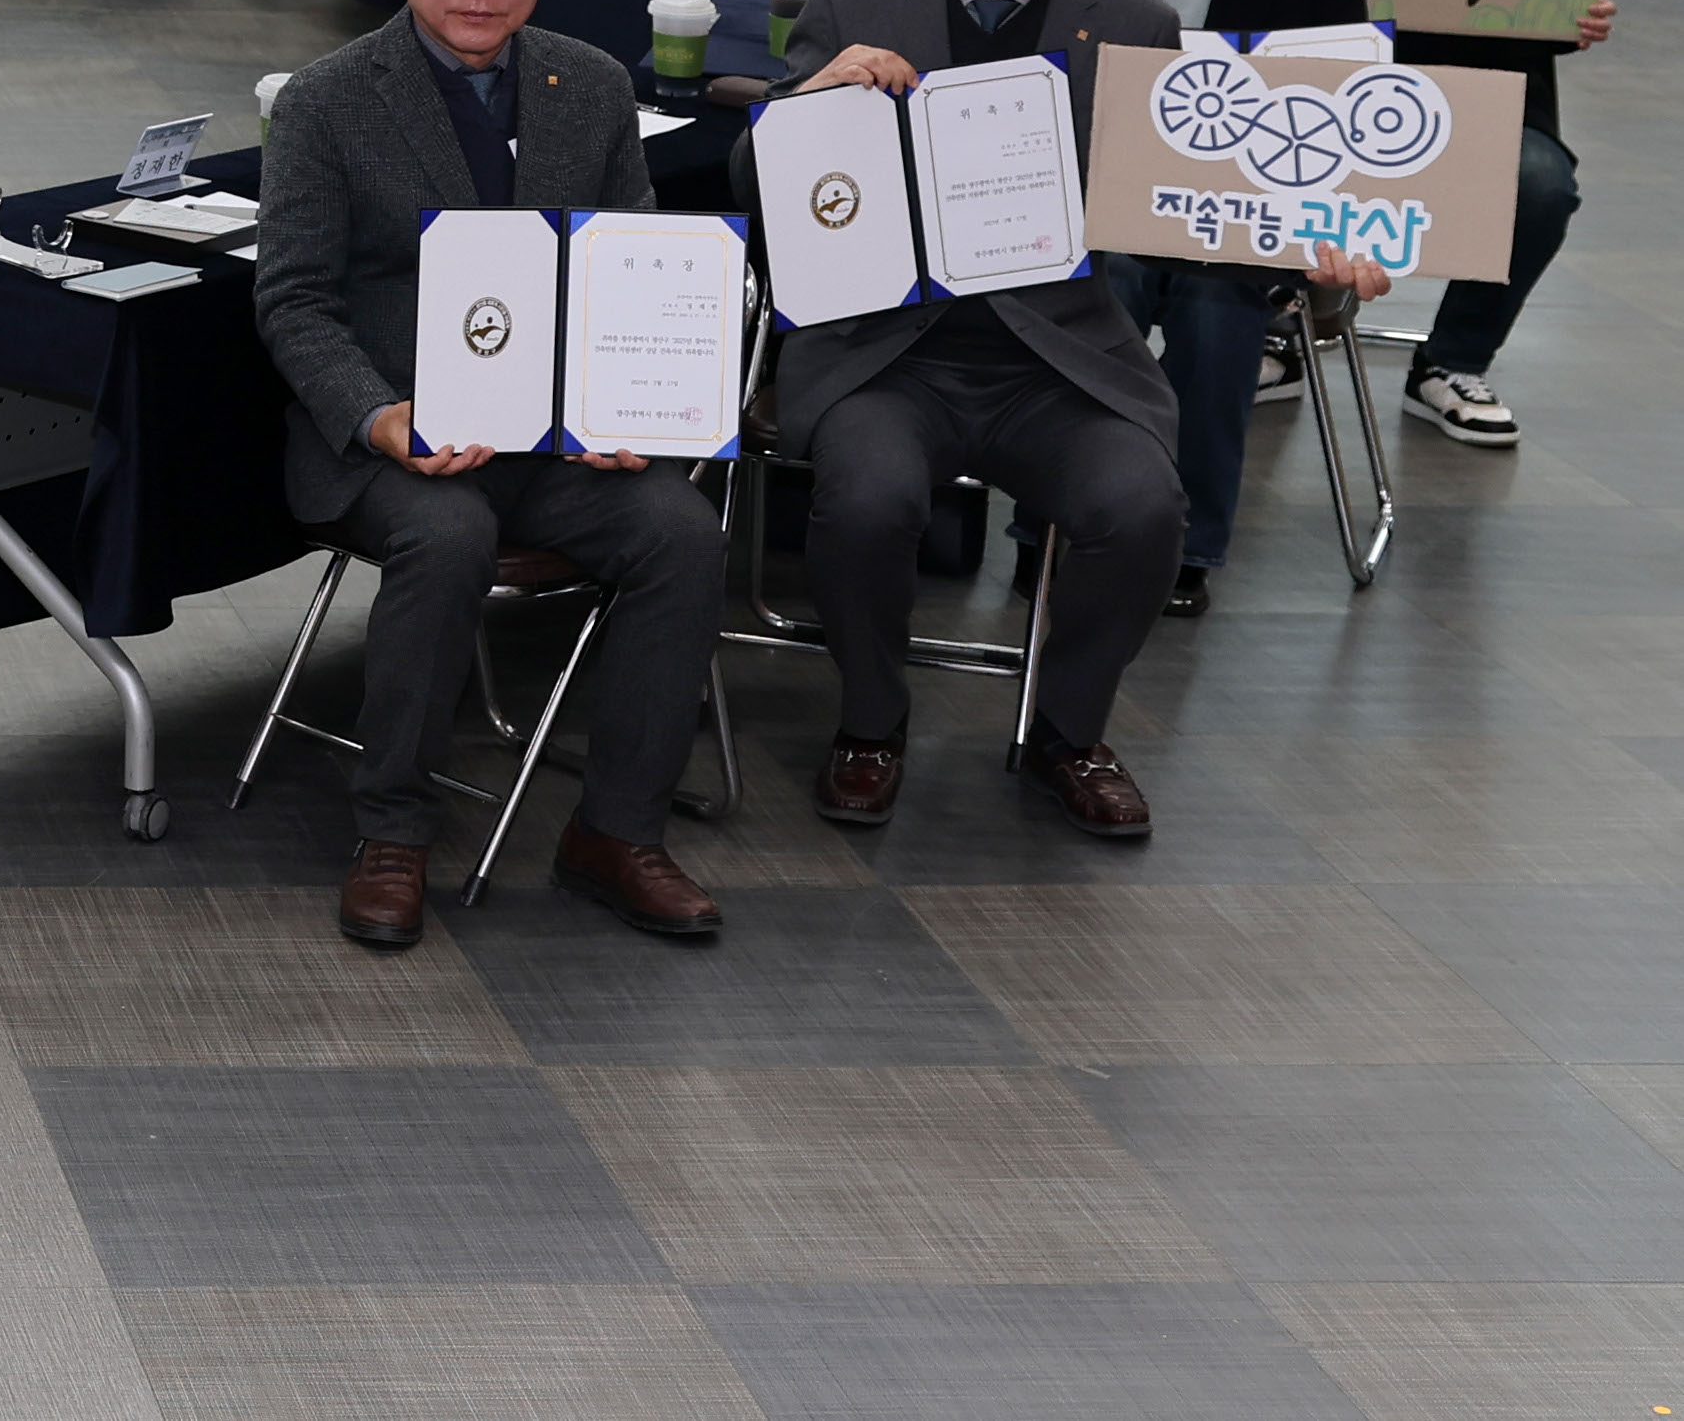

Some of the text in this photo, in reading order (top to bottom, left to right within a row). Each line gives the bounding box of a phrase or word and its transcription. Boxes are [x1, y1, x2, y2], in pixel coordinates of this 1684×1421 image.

[131, 151, 184, 179] 정재한
[1156, 193, 1425, 269] 지속가능 광산
